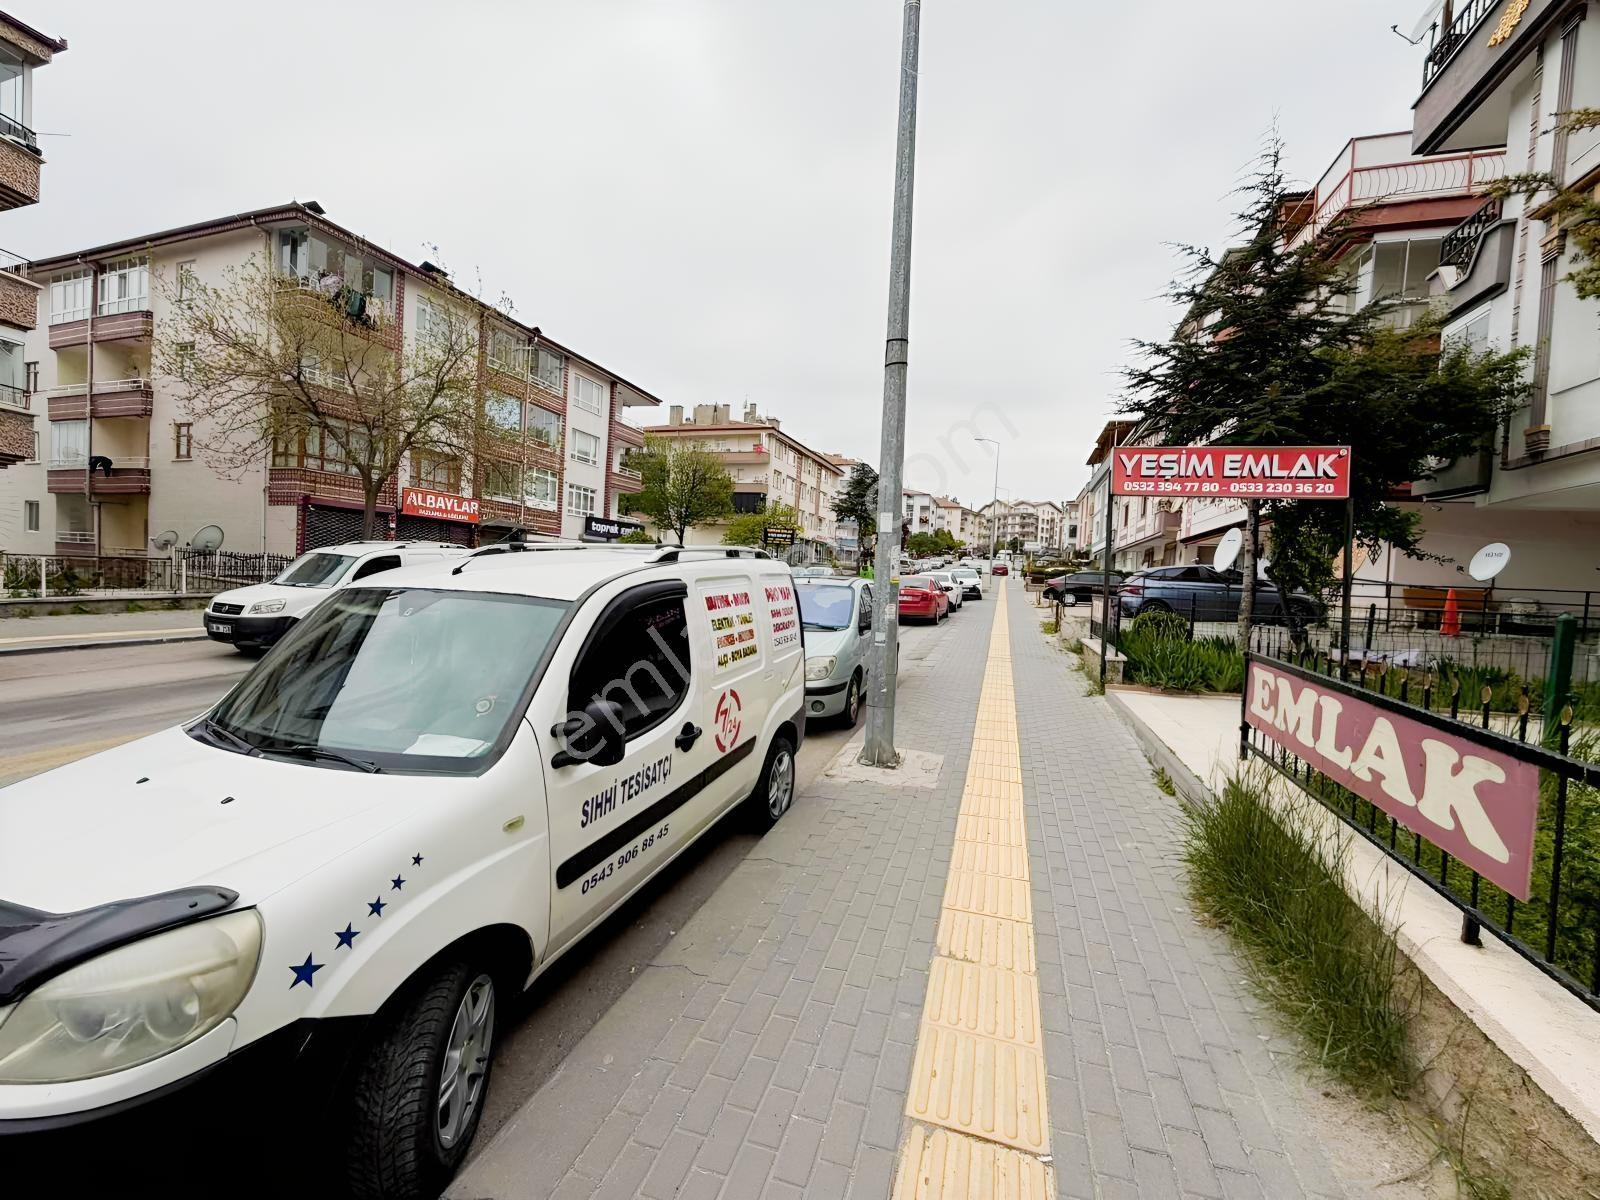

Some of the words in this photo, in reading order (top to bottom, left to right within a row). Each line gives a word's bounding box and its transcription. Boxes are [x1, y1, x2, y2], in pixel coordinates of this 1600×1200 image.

[1119, 450, 1215, 480] YEŞİM
[1223, 453, 1338, 479] EMLAK
[1157, 482, 1182, 492] 394
[1184, 482, 1199, 492] 77
[1266, 483, 1293, 493] 230
[1295, 483, 1313, 493] 36
[1315, 483, 1335, 493] 20
[406, 491, 479, 515] ALBAYLAR
[591, 521, 619, 535] toprak
[1249, 667, 1510, 864] EMLAK
[581, 779, 618, 828] SIHHİ
[620, 753, 673, 804] TESİSATÇI
[581, 863, 614, 895] 0543
[617, 847, 639, 870] 906
[641, 834, 654, 852] 88
[656, 823, 670, 839] 45
